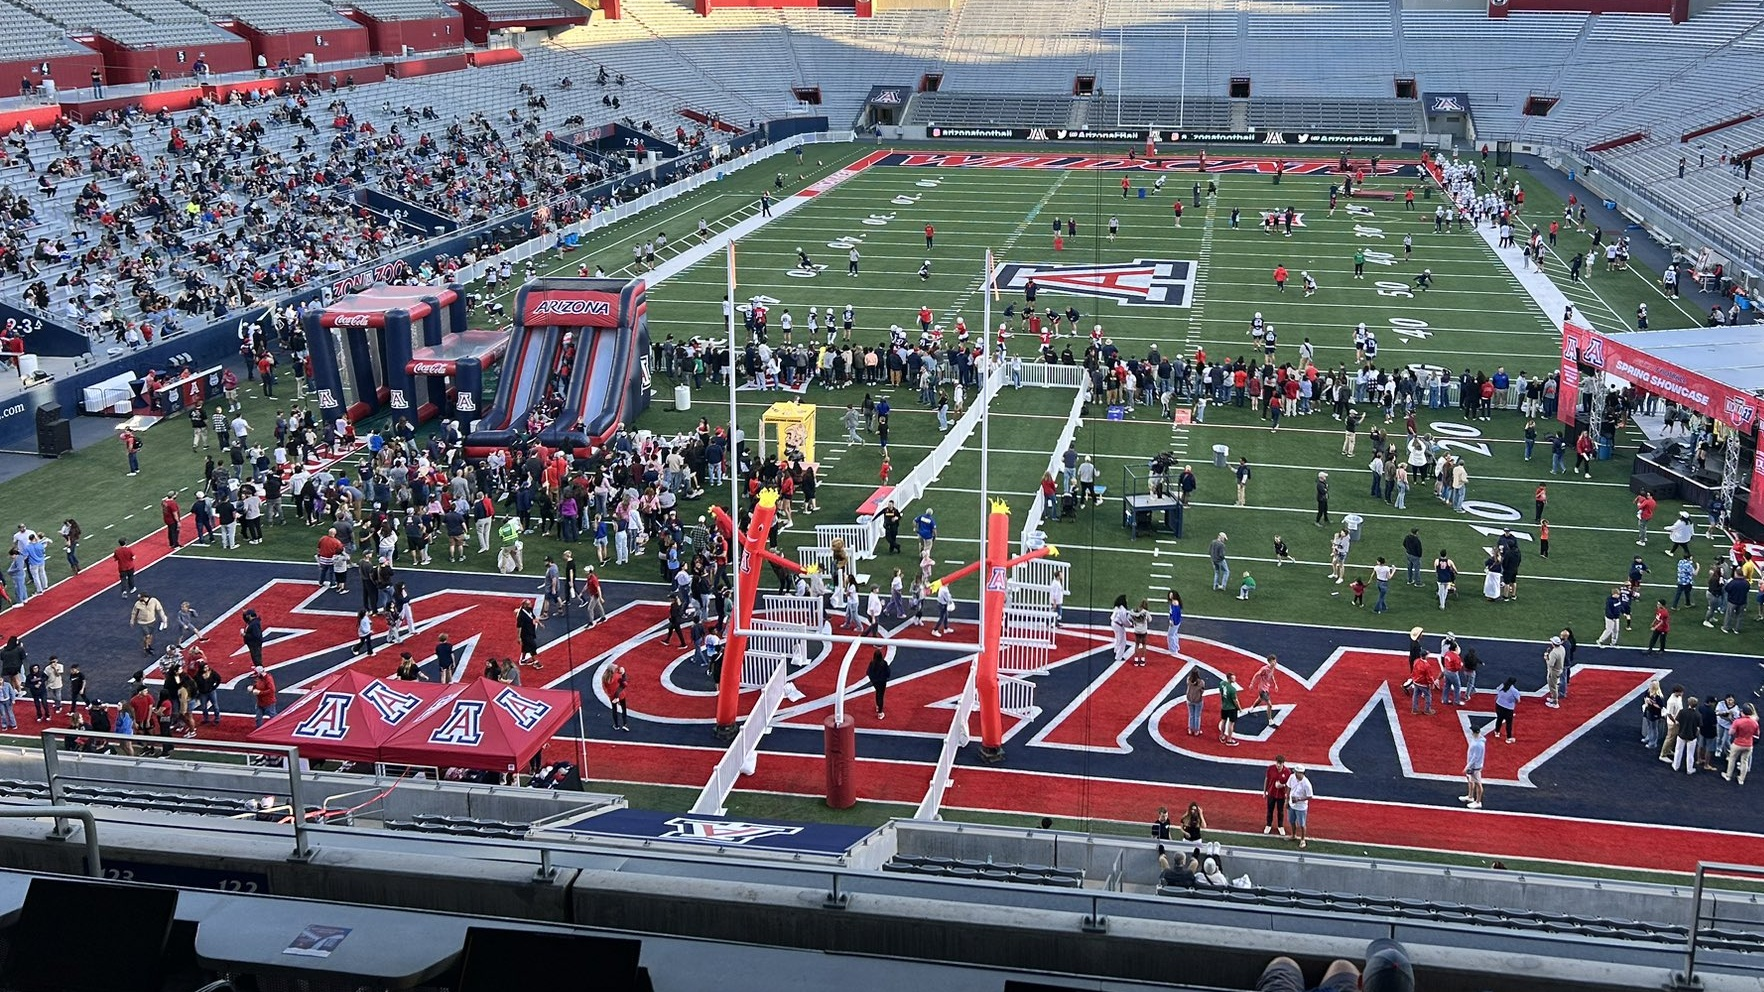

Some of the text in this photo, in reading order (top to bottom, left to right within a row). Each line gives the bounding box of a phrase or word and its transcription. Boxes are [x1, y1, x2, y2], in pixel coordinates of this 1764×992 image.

[625, 137, 639, 147] 7-8
[1374, 281, 1415, 298] 50
[533, 299, 610, 316] ARIZONA
[1388, 317, 1434, 339] 40
[1587, 336, 1605, 368] A
[1615, 360, 1651, 383] SPRING
[1650, 374, 1710, 406] SHOWCASE
[318, 388, 339, 409] A
[390, 389, 410, 409] A
[456, 391, 476, 412] A
[1429, 421, 1492, 457] 20
[1461, 500, 1533, 541] 10
[986, 566, 1007, 592] A
[291, 691, 357, 741] A
[358, 678, 423, 725] A
[493, 686, 552, 731] A
[427, 699, 487, 747] A
